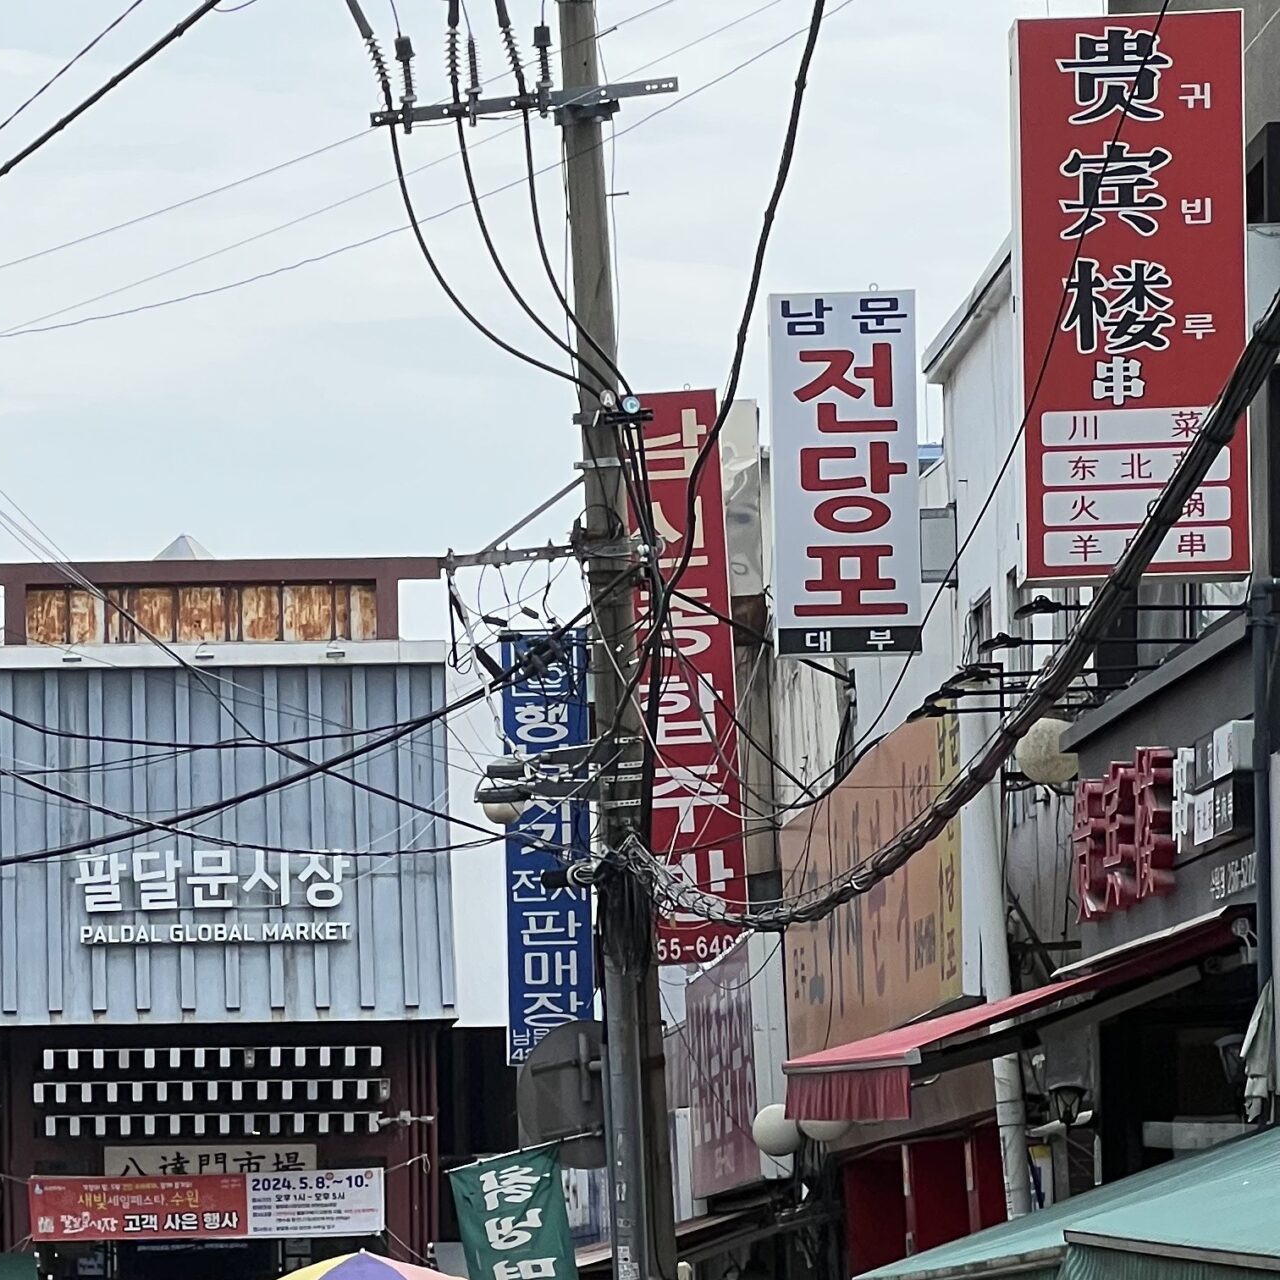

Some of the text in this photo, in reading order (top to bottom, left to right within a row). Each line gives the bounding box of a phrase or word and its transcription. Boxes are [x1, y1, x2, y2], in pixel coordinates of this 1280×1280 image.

[1178, 82, 1217, 340] 귀빈루
[780, 297, 908, 336] 남문
[1092, 356, 1145, 405] 串
[1067, 411, 1203, 441] 川菜
[792, 342, 909, 618] 전당포
[1067, 452, 1190, 481] 东北
[1068, 530, 1207, 563] 羊串
[804, 629, 895, 652] 대부
[75, 850, 350, 912] 팔달문시장
[80, 922, 351, 944] PALDAL GLOBAL MARKET
[123, 1214, 158, 1232] 고객
[163, 1213, 198, 1231] 사은
[203, 1211, 239, 1230] 행사
